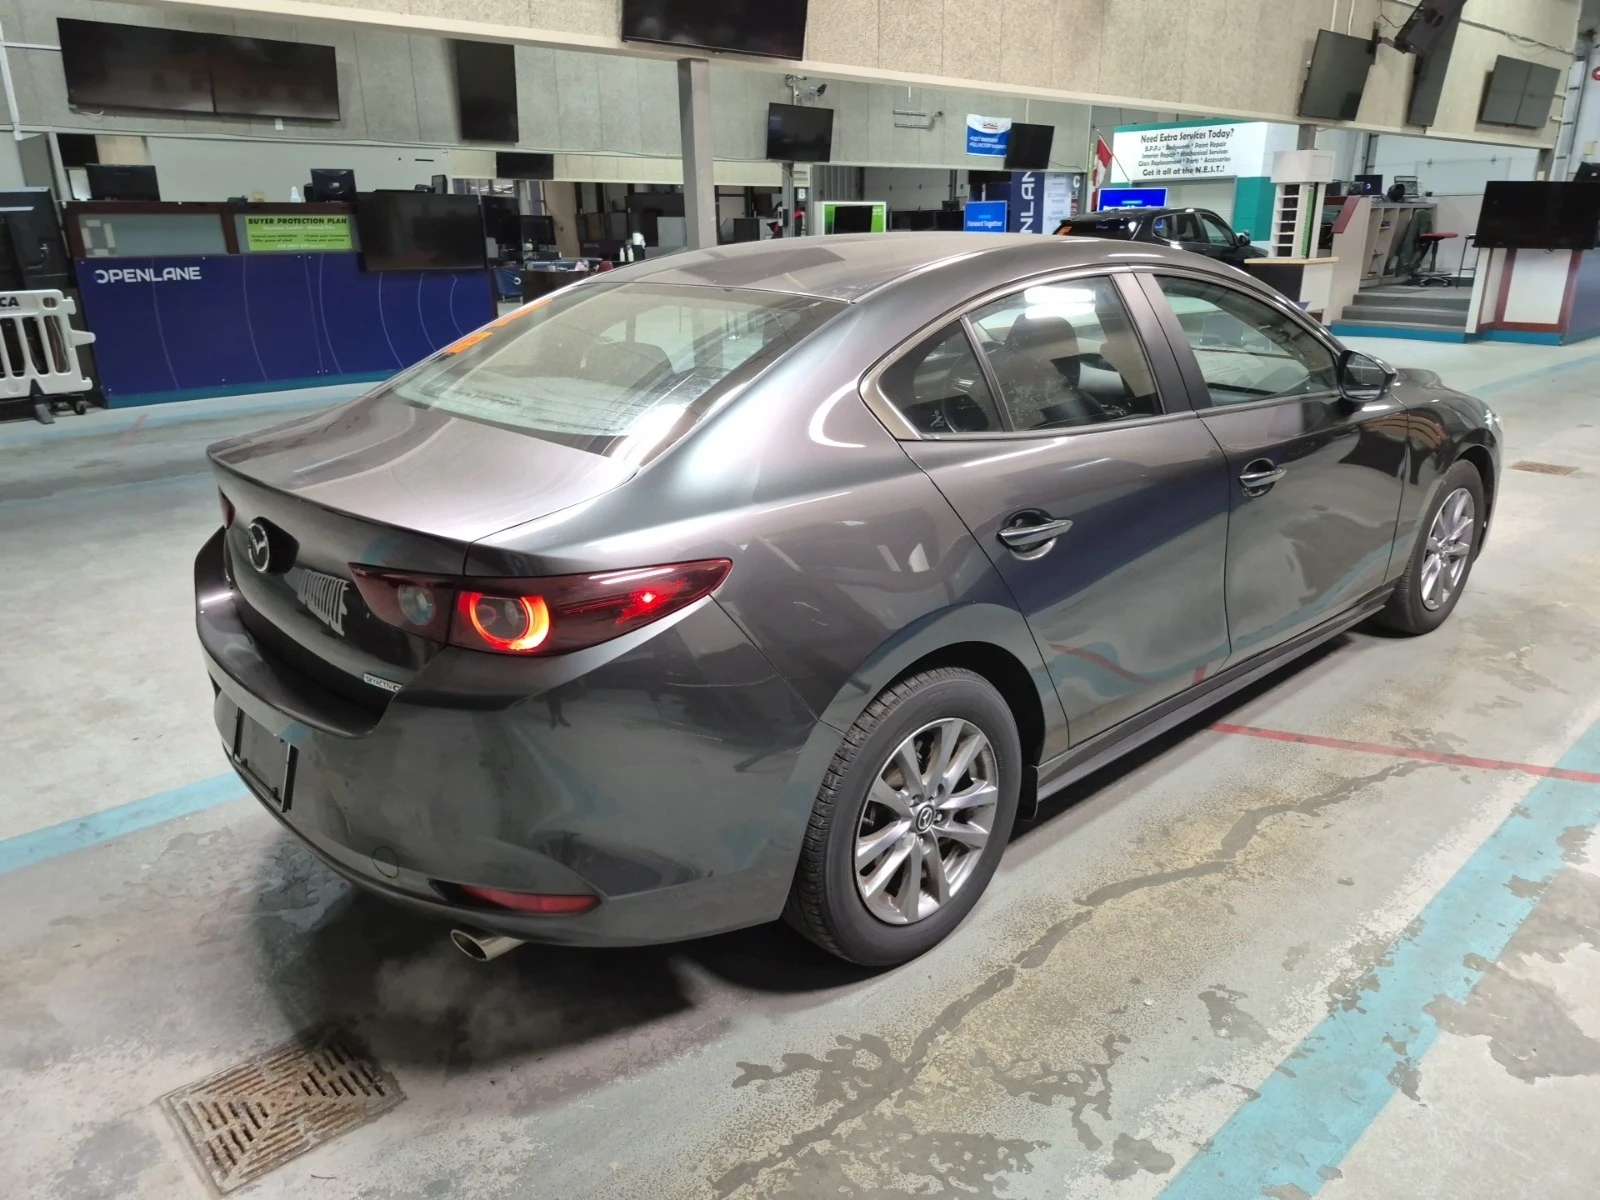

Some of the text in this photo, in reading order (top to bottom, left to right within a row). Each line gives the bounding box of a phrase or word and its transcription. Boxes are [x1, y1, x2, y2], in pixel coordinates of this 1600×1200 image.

[1141, 128, 1234, 143] Need Extra Services Today?
[1073, 175, 1080, 188] C
[798, 188, 806, 199] B
[967, 220, 1002, 229] Forward Together
[95, 266, 202, 283] OPENLANE
